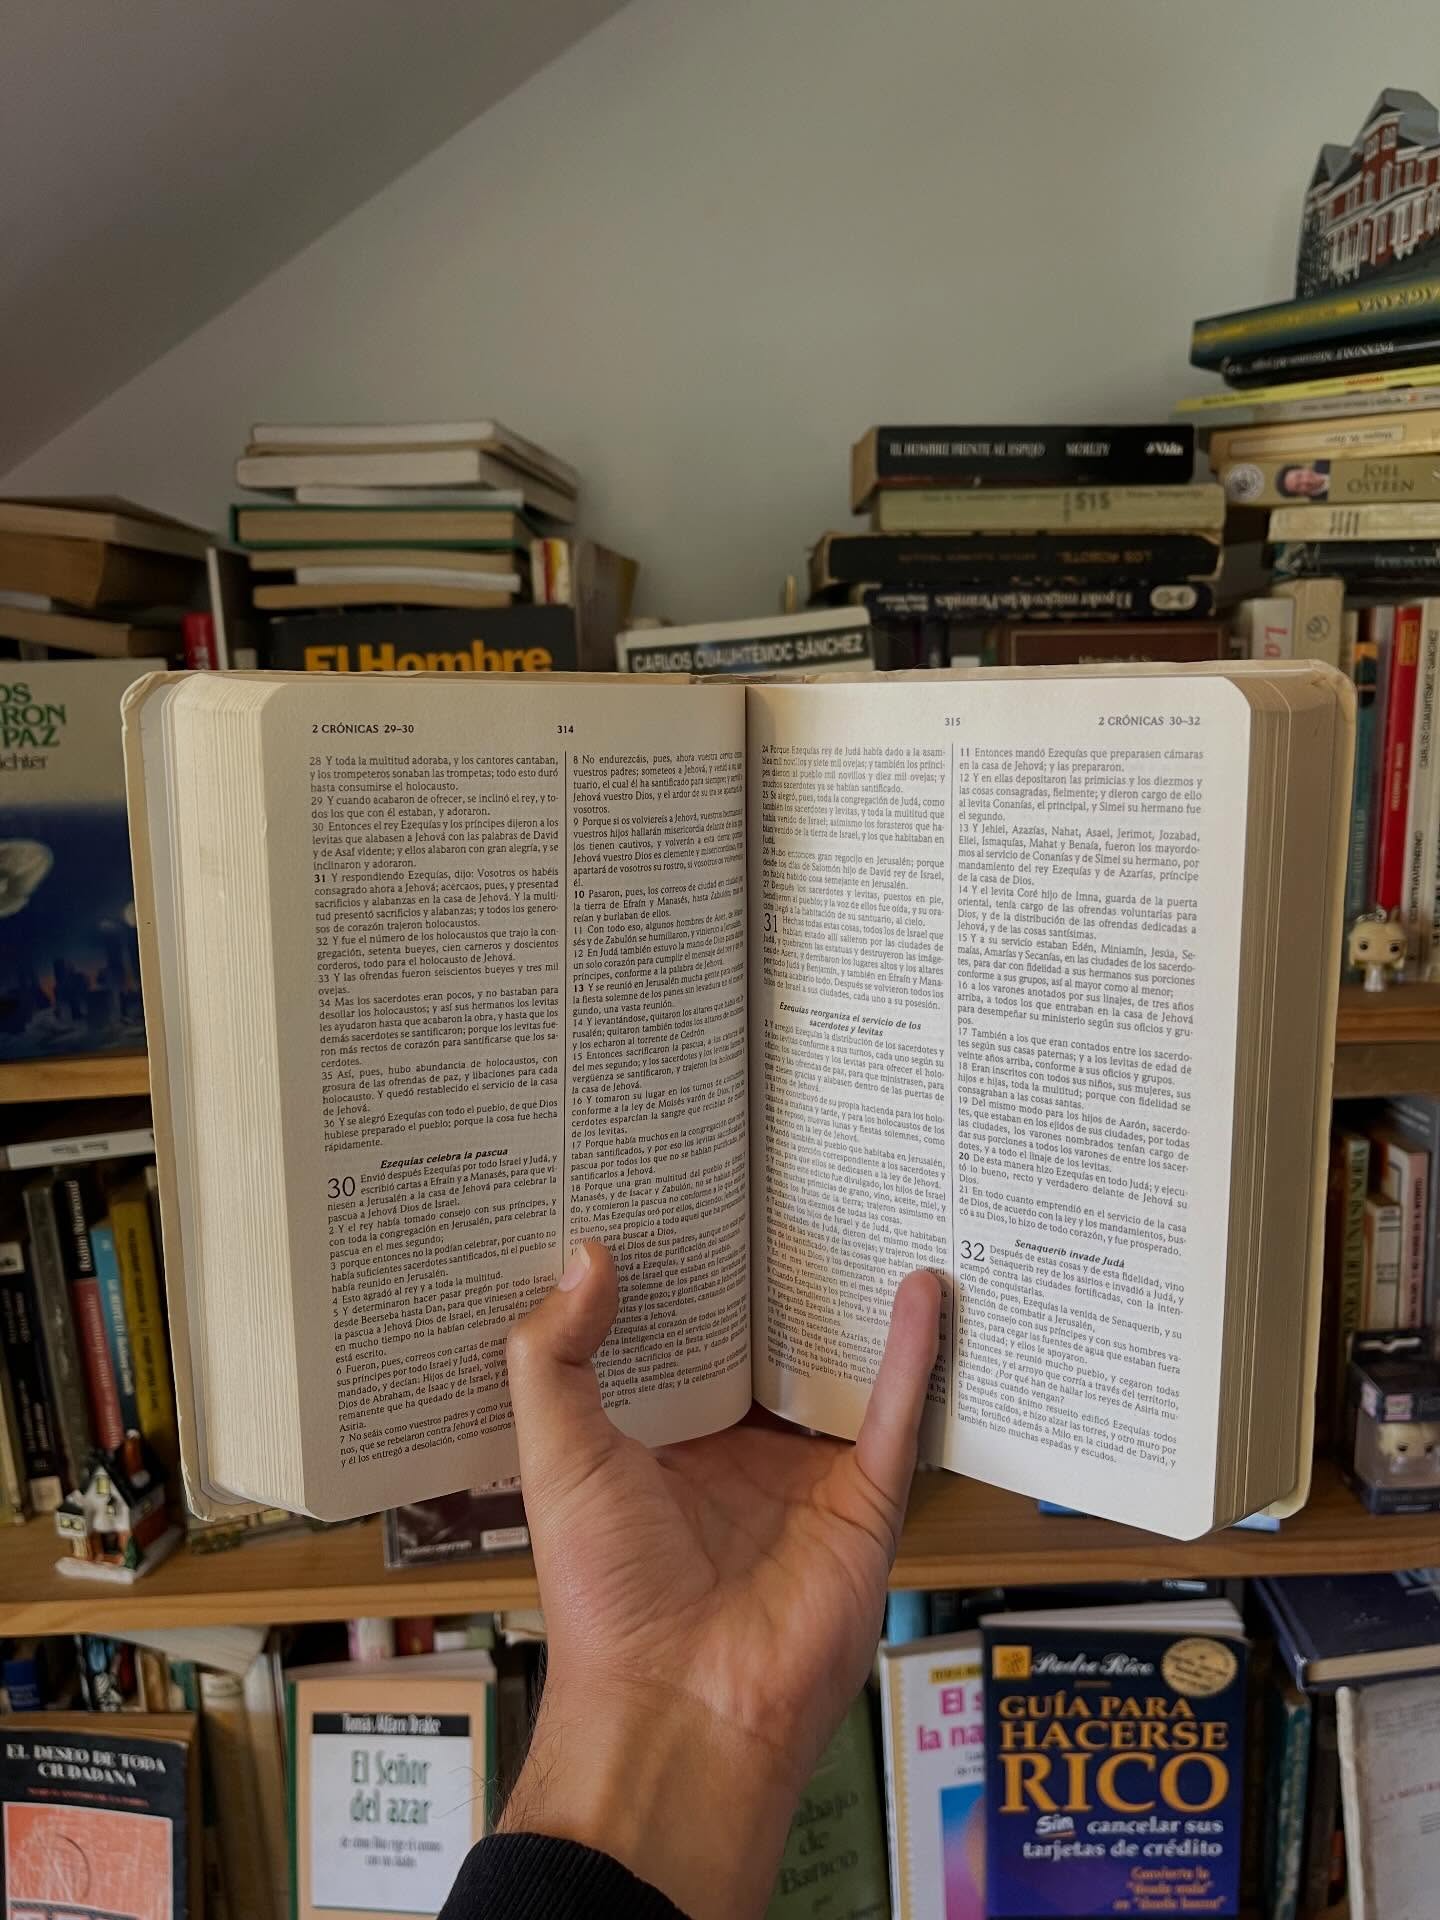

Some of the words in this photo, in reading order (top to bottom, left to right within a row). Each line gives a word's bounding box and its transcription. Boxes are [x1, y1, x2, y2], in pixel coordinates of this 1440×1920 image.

[1364, 463, 1399, 477] JOEL
[1347, 479, 1416, 495] OSTEEN
[304, 645, 349, 671] El
[358, 639, 552, 671] Hombre
[632, 650, 692, 672] CARLOS
[795, 632, 864, 659] SÁNCHEZ
[312, 725, 319, 734] 2
[321, 721, 379, 734] CRÓNICAS
[556, 725, 575, 735] 314
[944, 717, 961, 727] 315
[1098, 717, 1105, 726] 2
[1107, 714, 1165, 726] CRÓNICAS
[3, 726, 61, 748] PAZ
[309, 756, 321, 765] 28
[325, 755, 332, 765] Y
[335, 755, 356, 765] toda
[357, 755, 367, 765] la
[368, 755, 410, 765] multitud
[411, 755, 451, 766] adoraba,
[453, 757, 459, 767] y
[460, 755, 474, 764] los
[475, 756, 514, 764] cantores
[514, 754, 560, 765] cantaban,
[960, 747, 969, 757] 11
[974, 747, 1012, 758] Entonces
[1015, 747, 1045, 758] mandó
[1047, 747, 1087, 760] Ezequías
[1089, 750, 1107, 760] que
[1109, 749, 1161, 761] preparasen
[1163, 748, 1203, 759] cámaras
[309, 771, 315, 781] y
[316, 768, 331, 779] los
[332, 769, 390, 781] trompeteros
[391, 767, 430, 778] sonaban
[431, 767, 445, 777] las
[444, 768, 495, 780] trompetas;
[496, 766, 517, 777] todo
[517, 768, 537, 777] esto
[537, 767, 558, 777] duró
[981, 761, 999, 770] casa
[1013, 759, 1047, 773] Jehová;
[1056, 760, 1070, 771] las
[1071, 762, 1124, 774] prepararon.
[310, 782, 337, 793] hasta
[337, 781, 392, 792] consumirse
[394, 781, 403, 791] el
[405, 780, 459, 791] holocausto.
[335, 794, 371, 805] cuando
[373, 794, 415, 804] acabaron
[430, 792, 465, 804] ofrecer,
[478, 792, 510, 803] inclinó
[521, 794, 538, 804] rey,
[547, 793, 558, 802] to-
[763, 912, 778, 933] 31
[779, 1001, 808, 1014] Ezequías
[811, 1008, 850, 1020] reorganiza
[862, 1016, 893, 1026] servicio
[908, 1020, 921, 1030] los
[809, 1020, 849, 1031] sacerdotes
[857, 1025, 883, 1036] levitas
[380, 1157, 424, 1169] Ezequías
[427, 1152, 462, 1163] celebra
[475, 1148, 508, 1159] pascua
[327, 1176, 356, 1199] 30
[960, 1240, 986, 1262] 32
[1014, 1238, 1066, 1256] Senaquerib
[1069, 1250, 1101, 1263] invade
[1101, 1257, 1124, 1268] Judá
[1099, 1654, 1155, 1676] Rico
[939, 1686, 964, 1715] El
[998, 1690, 1092, 1719] GUÍA
[1099, 1696, 1196, 1719] PARA
[916, 1724, 941, 1752] la
[1000, 1720, 1229, 1751] HACERSE
[6, 1743, 30, 1760] EL
[34, 1744, 90, 1764] DESEO
[92, 1749, 116, 1767] DE
[117, 1752, 167, 1774] TODA
[350, 1749, 369, 1784] El
[374, 1749, 433, 1785] Señor
[37, 1761, 137, 1788] CIUDADANA
[998, 1751, 1231, 1815] RICO
[349, 1788, 382, 1822] del
[386, 1796, 432, 1824] azar
[1035, 1813, 1075, 1836] Sin
[1087, 1816, 1181, 1834] cancelar
[1184, 1819, 1224, 1834] sus
[1022, 1839, 1106, 1861] tarjetas
[1110, 1839, 1140, 1857] de
[1143, 1838, 1224, 1857] crédito
